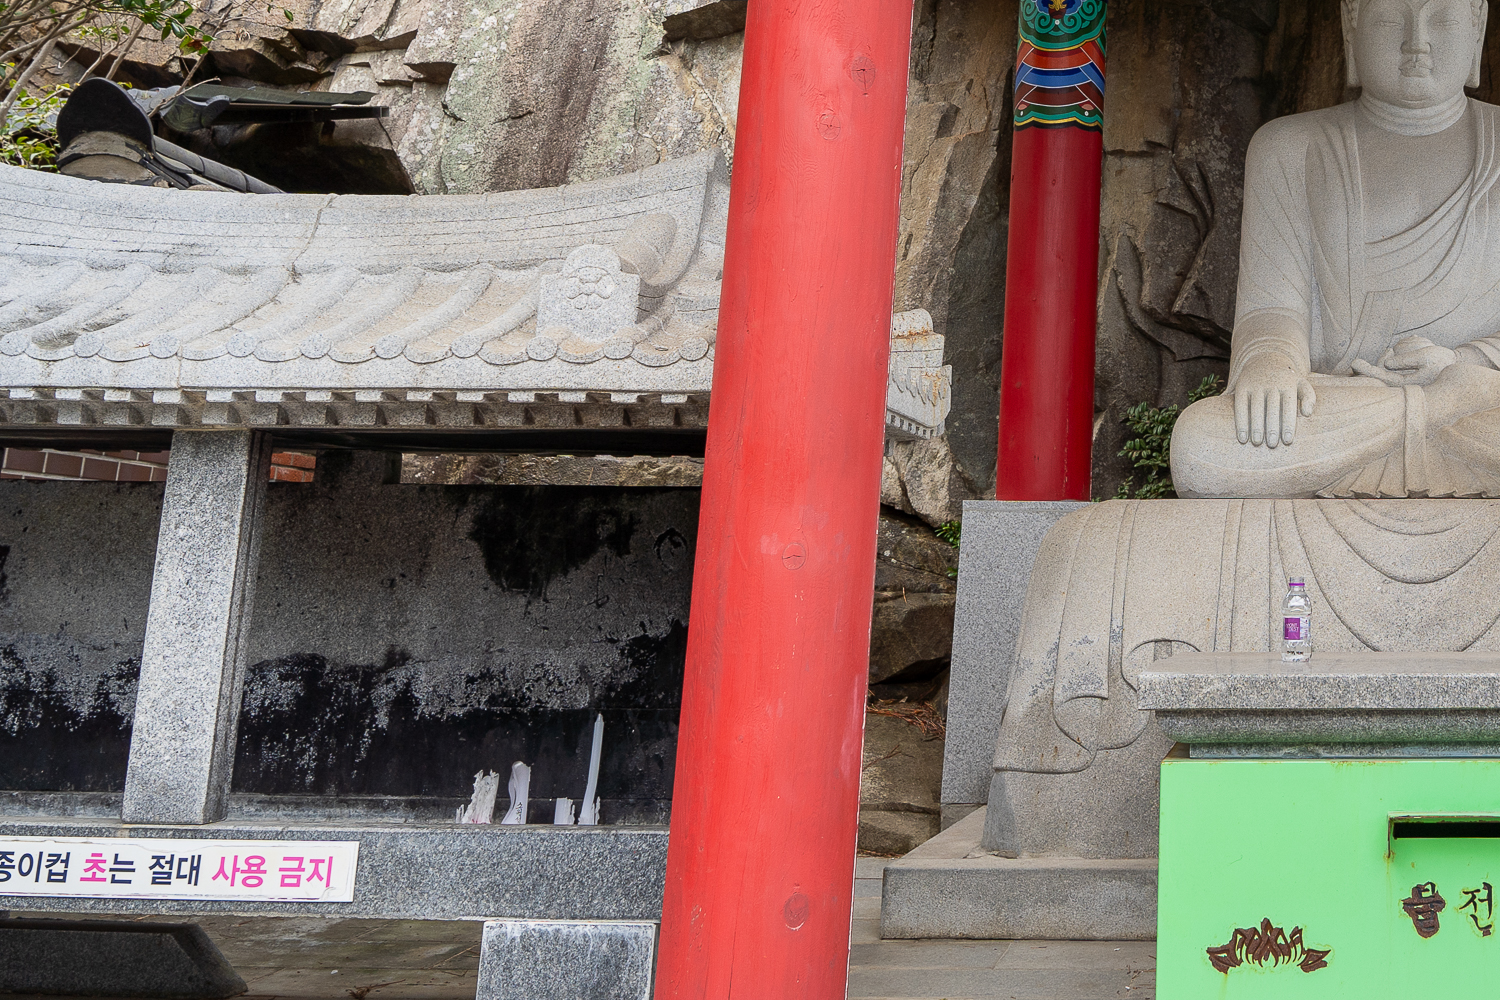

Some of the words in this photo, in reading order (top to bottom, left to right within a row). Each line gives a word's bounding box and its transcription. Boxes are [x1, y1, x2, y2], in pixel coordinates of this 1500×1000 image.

[79, 852, 137, 885] 초는
[148, 854, 202, 886] 절대
[211, 855, 268, 888] 사용
[278, 855, 334, 888] 금지
